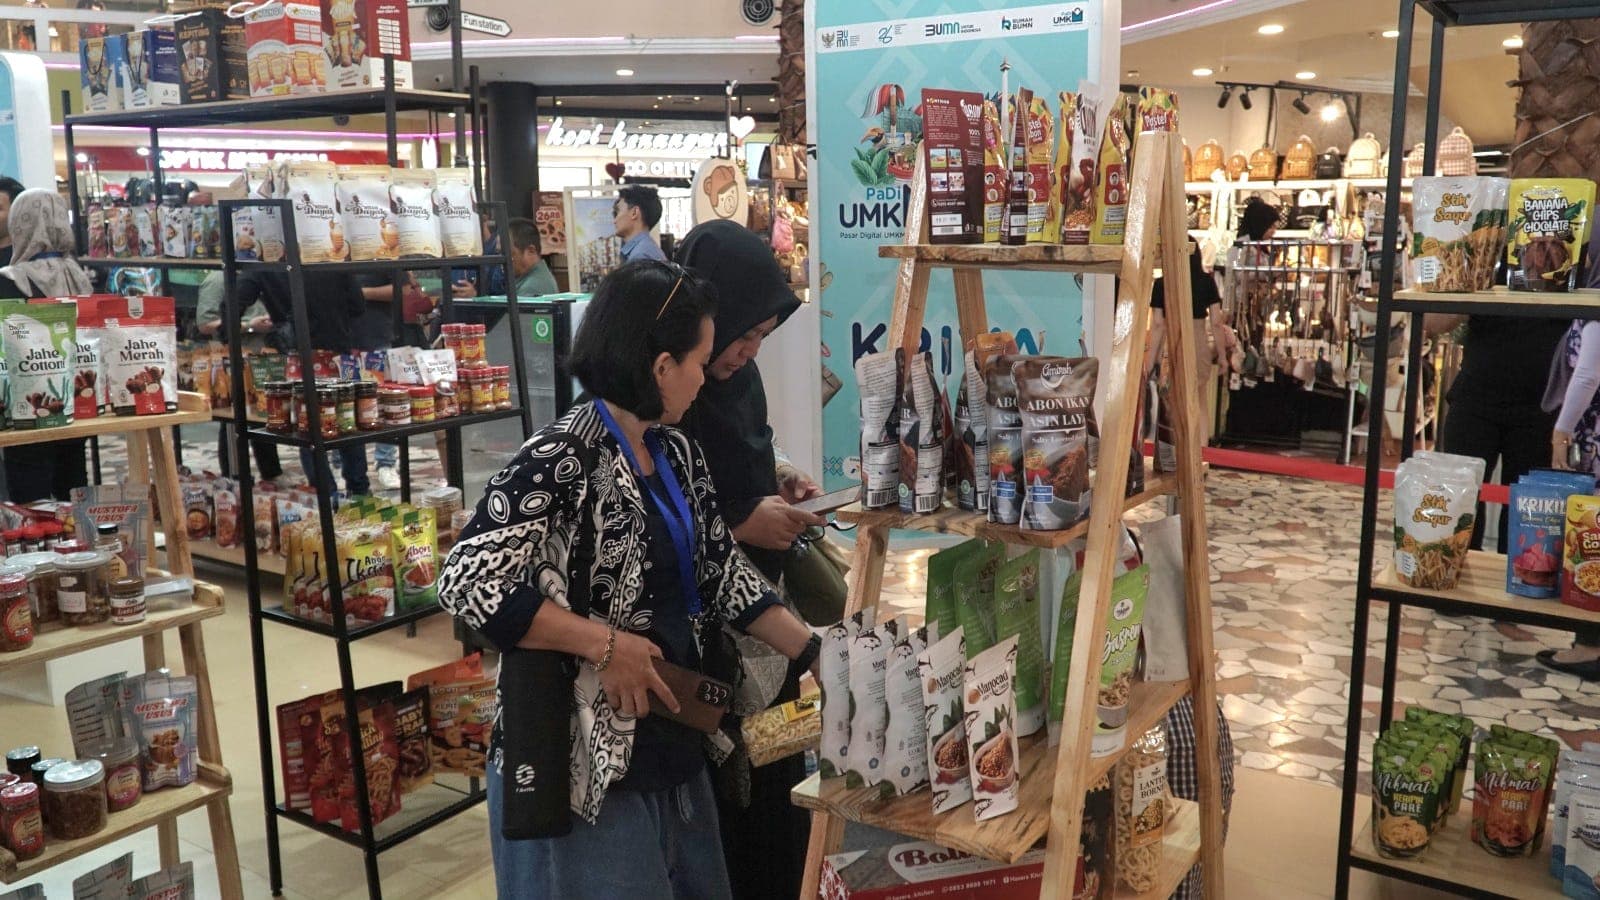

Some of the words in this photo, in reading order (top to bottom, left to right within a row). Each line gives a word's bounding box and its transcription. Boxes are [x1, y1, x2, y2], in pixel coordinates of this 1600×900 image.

[545, 116, 604, 148] kopi
[607, 119, 729, 152] kenangan
[866, 187, 901, 200] PaDi
[1441, 192, 1468, 208] Stik
[1524, 198, 1568, 211] BANANA
[1434, 207, 1472, 225] Sayur
[1533, 210, 1560, 221] CHIPS
[860, 232, 881, 240] Digital
[124, 339, 157, 351] Jahe
[26, 348, 60, 361] Jahe
[119, 350, 164, 362] Merah
[1026, 399, 1063, 412] ABON
[1029, 414, 1060, 427] ASIN
[96, 514, 126, 523] USUS
[1378, 771, 1432, 797] Nikmat
[1484, 771, 1540, 796] Nikmat
